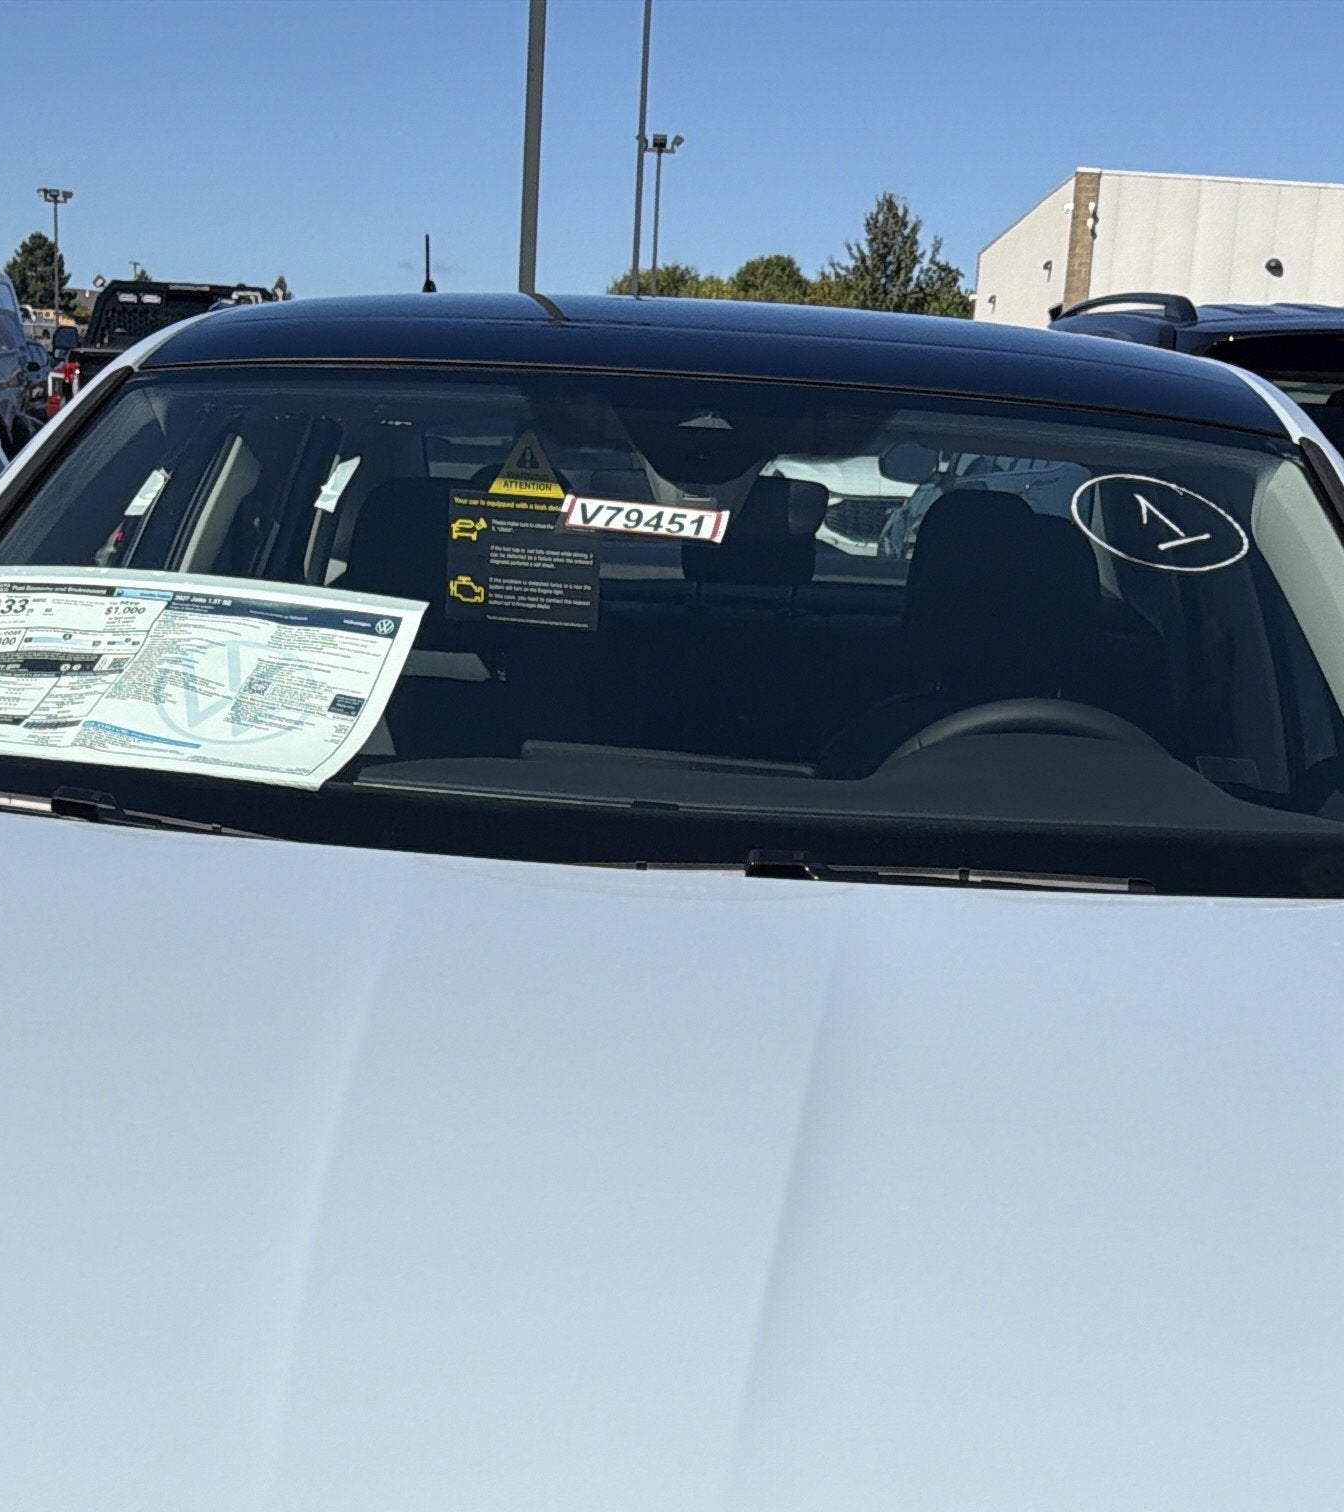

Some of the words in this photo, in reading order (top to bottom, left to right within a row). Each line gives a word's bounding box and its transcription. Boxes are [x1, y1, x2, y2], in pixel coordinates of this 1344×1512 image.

[503, 480, 552, 491] ATTENTION
[579, 502, 705, 537] V79451
[0, 599, 29, 614] 33
[104, 606, 146, 615] $1,000
